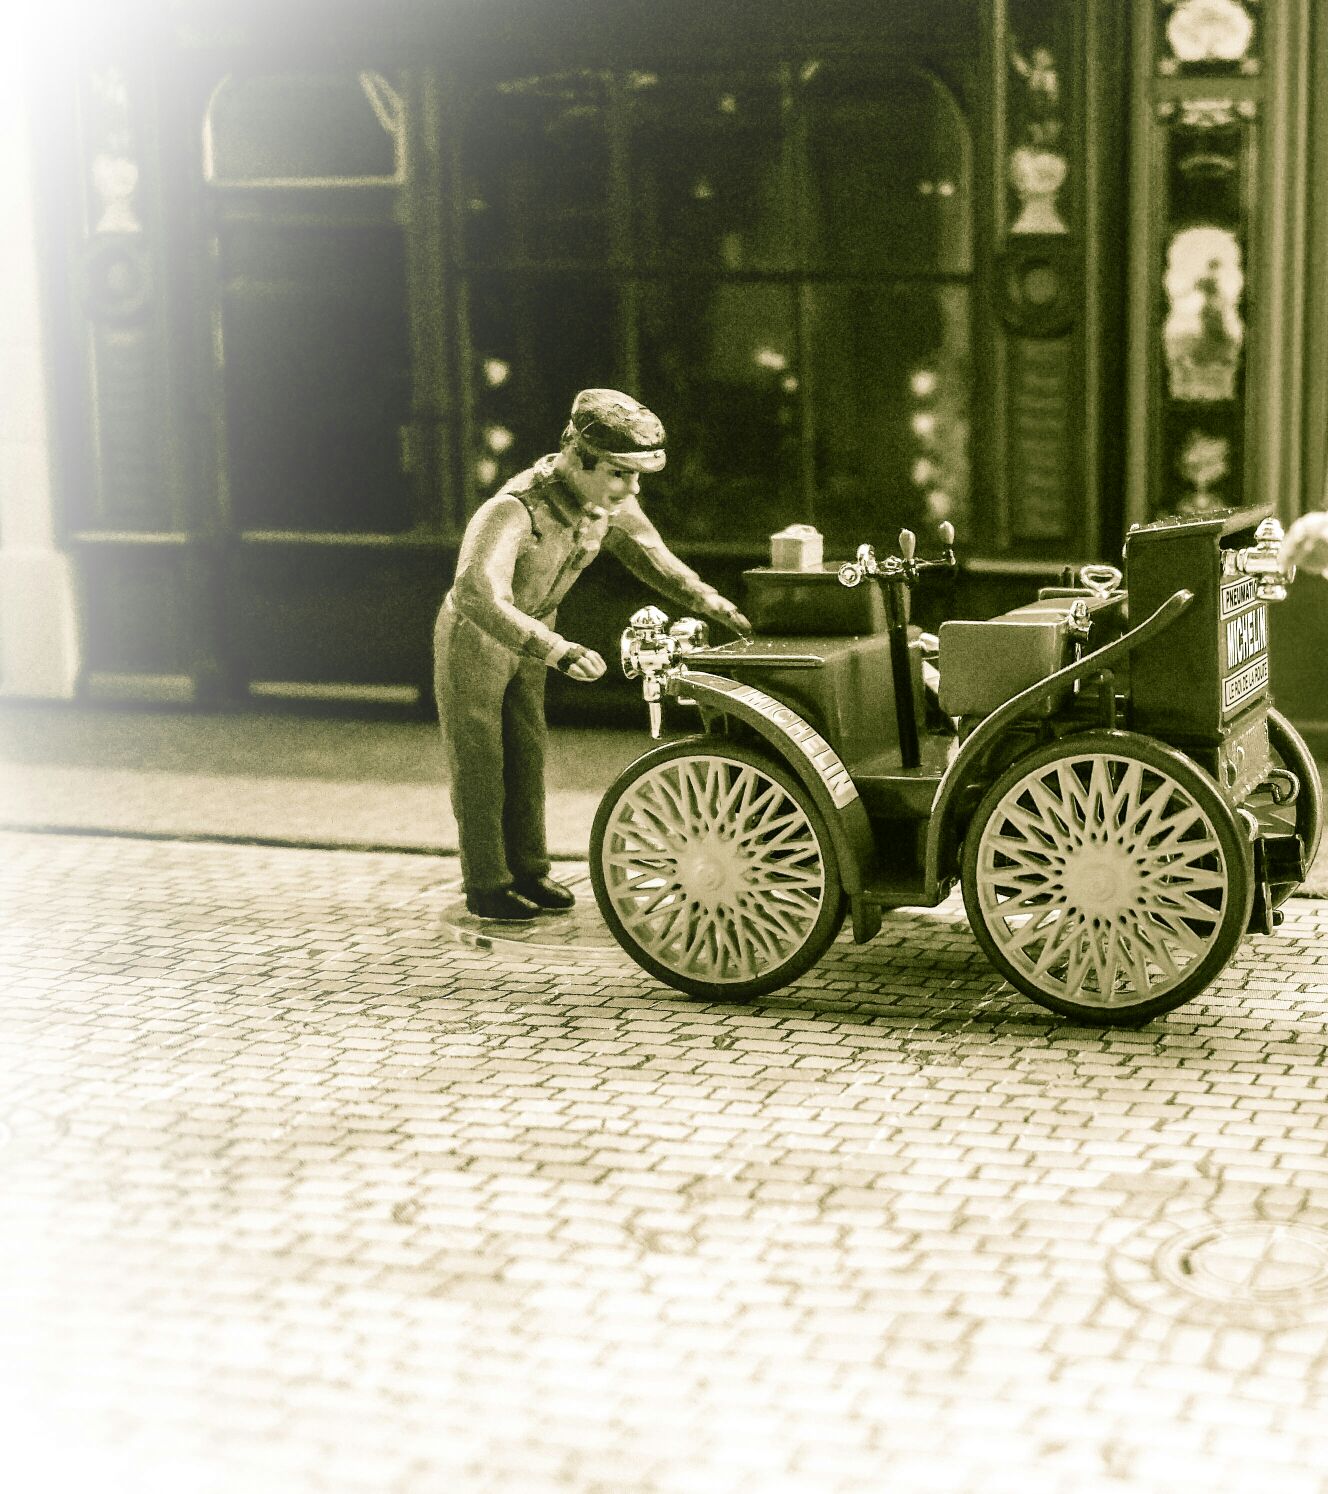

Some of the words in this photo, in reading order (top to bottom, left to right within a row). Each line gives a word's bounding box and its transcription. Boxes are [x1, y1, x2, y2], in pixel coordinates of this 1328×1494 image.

[1226, 579, 1257, 609] PNEUMATI
[1227, 605, 1267, 670] MICHELIN
[1254, 661, 1268, 682] ROUTE
[741, 689, 852, 797] MICHELIN
